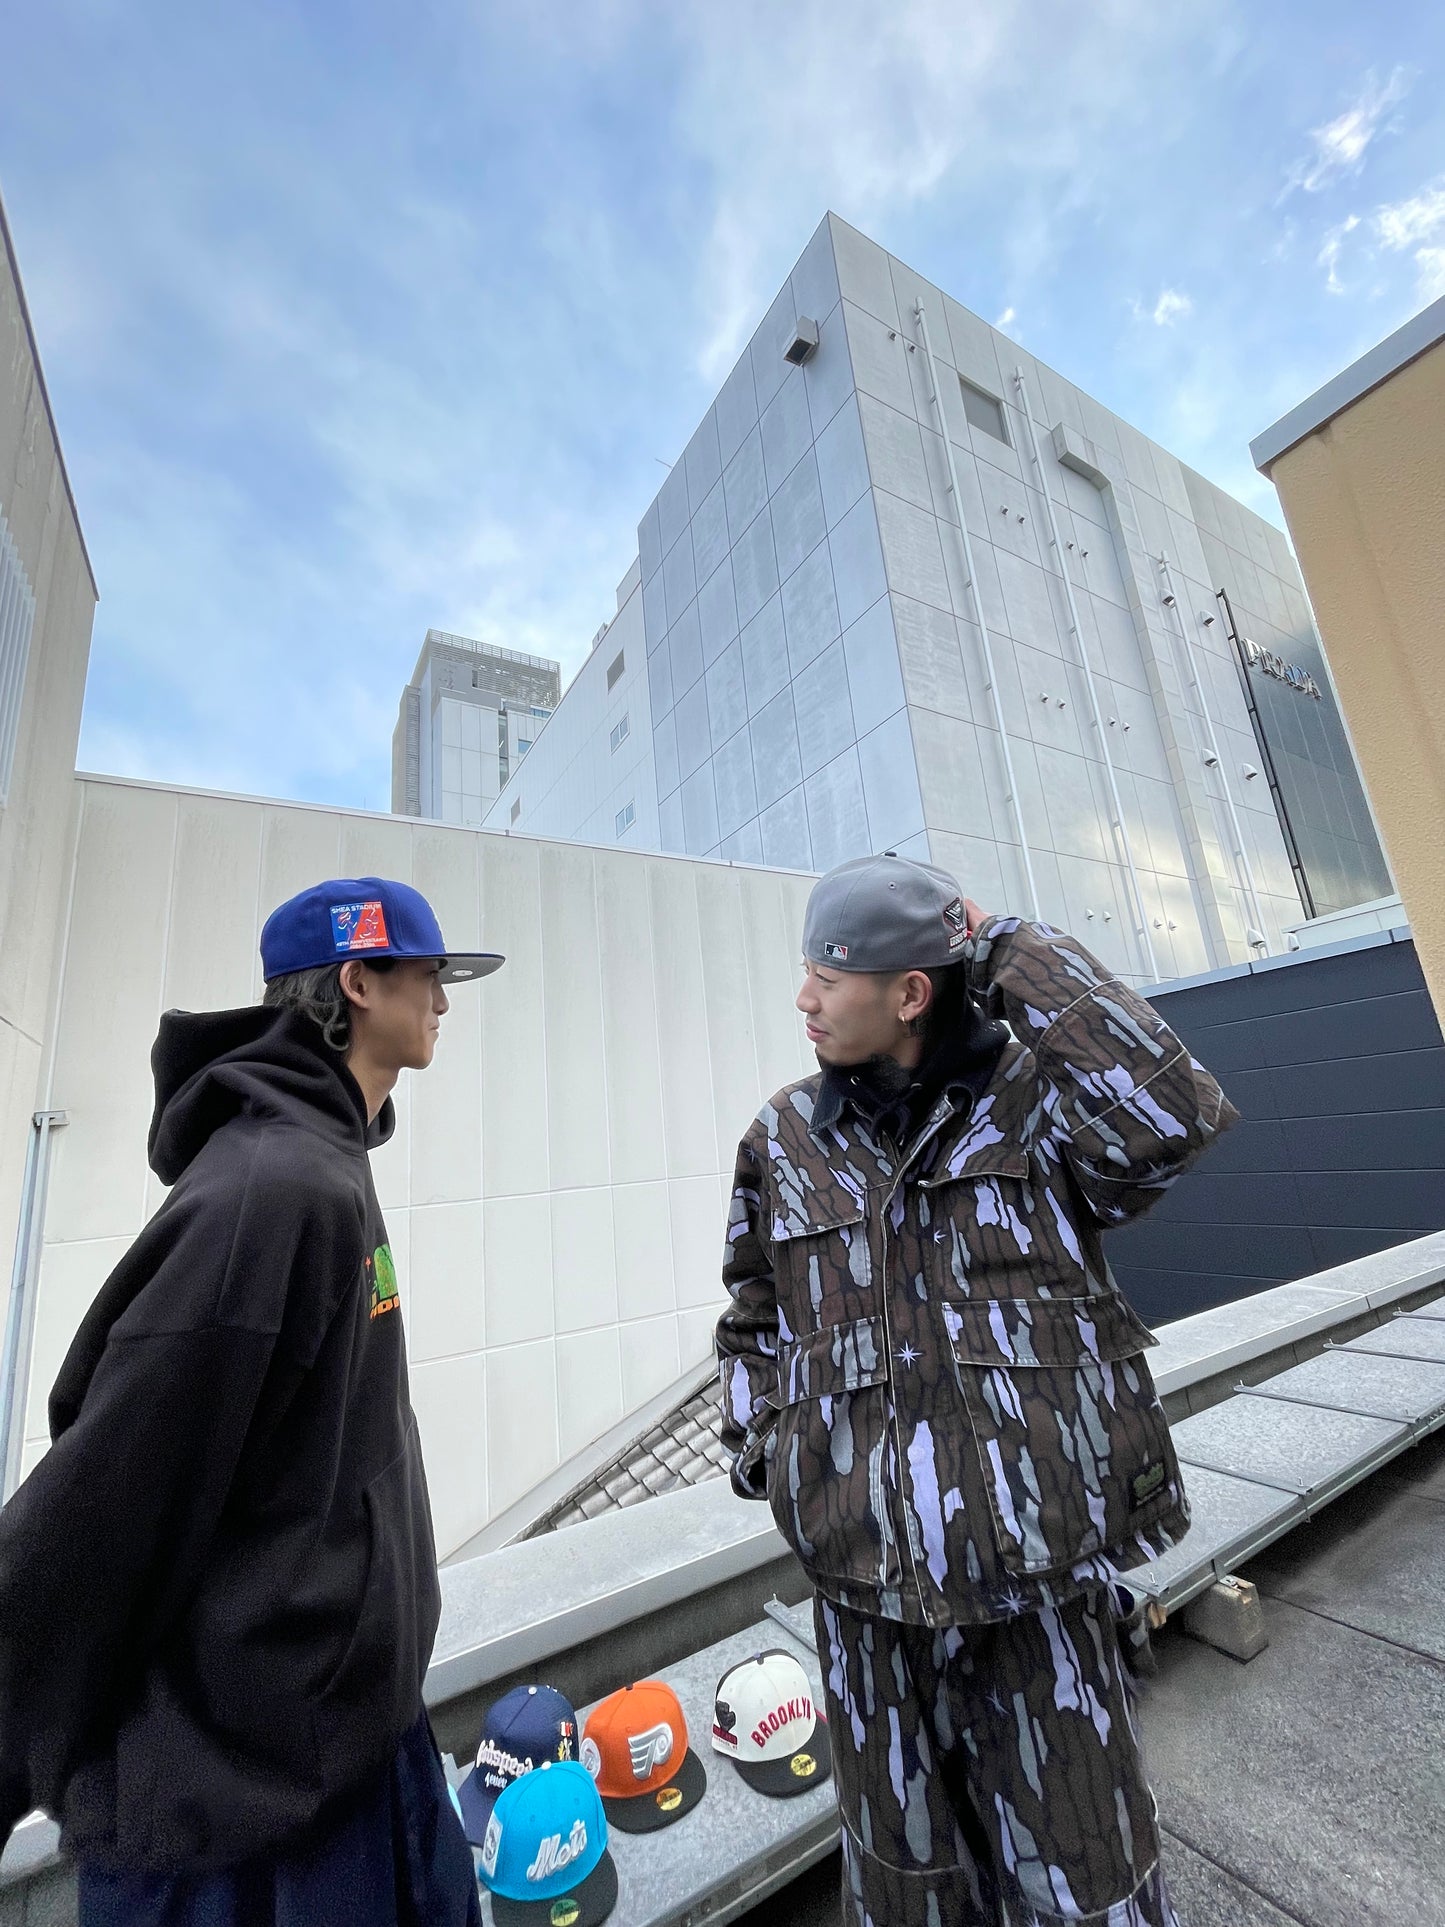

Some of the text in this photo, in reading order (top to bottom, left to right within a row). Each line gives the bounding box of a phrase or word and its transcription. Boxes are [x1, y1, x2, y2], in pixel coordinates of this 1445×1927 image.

[1241, 638, 1322, 699] PRADA
[351, 903, 382, 911] STADIUM
[526, 1819, 587, 1881] Mets
